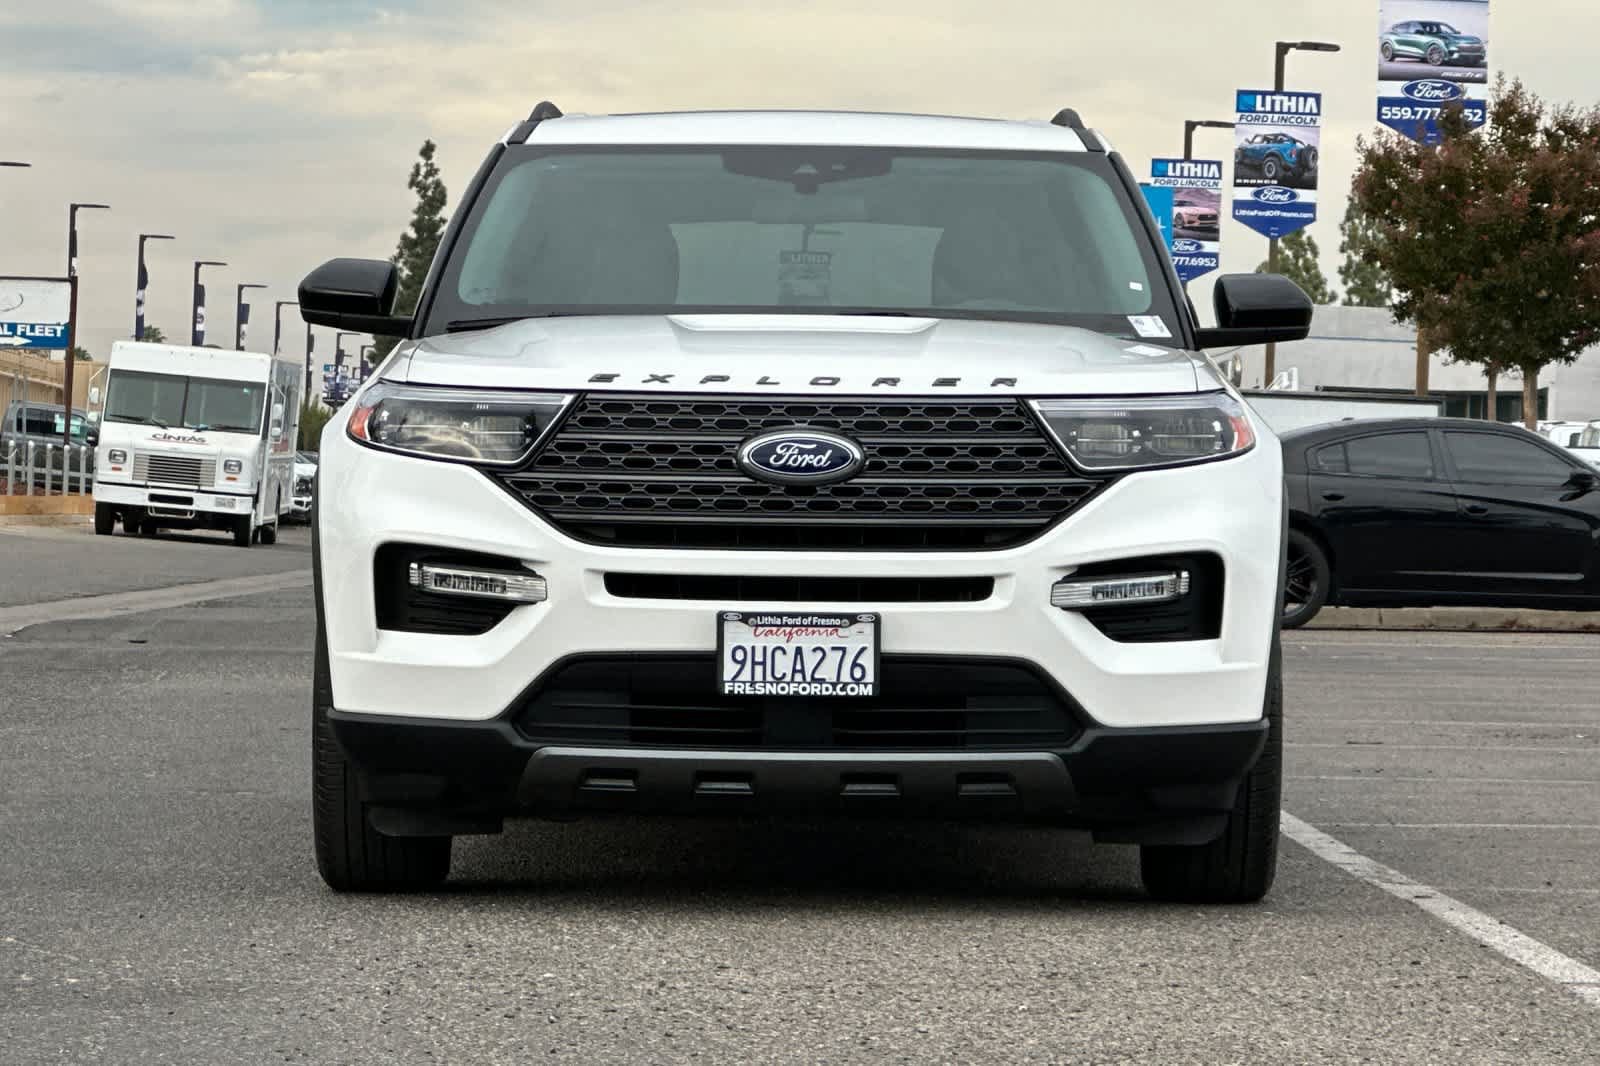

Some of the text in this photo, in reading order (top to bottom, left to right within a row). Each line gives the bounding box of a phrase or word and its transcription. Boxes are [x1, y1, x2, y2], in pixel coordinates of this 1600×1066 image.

[1413, 81, 1453, 97] Ford
[1255, 94, 1318, 113] LITHIA
[1239, 114, 1317, 125] FORD LINCOLN
[1381, 106, 1482, 122] 559.777.52
[1167, 162, 1220, 178] LITHIA
[1181, 180, 1219, 188] LINCOLN
[1260, 188, 1291, 202] Ford
[17, 324, 65, 338] FLEET
[588, 373, 1018, 388] EXPLORER
[769, 441, 832, 470] Ford
[757, 616, 841, 627] Lithia Ford of Fresno
[754, 626, 848, 643] California
[730, 645, 868, 683] 9HCA276
[724, 682, 873, 696] FRESNOFORD.COM
